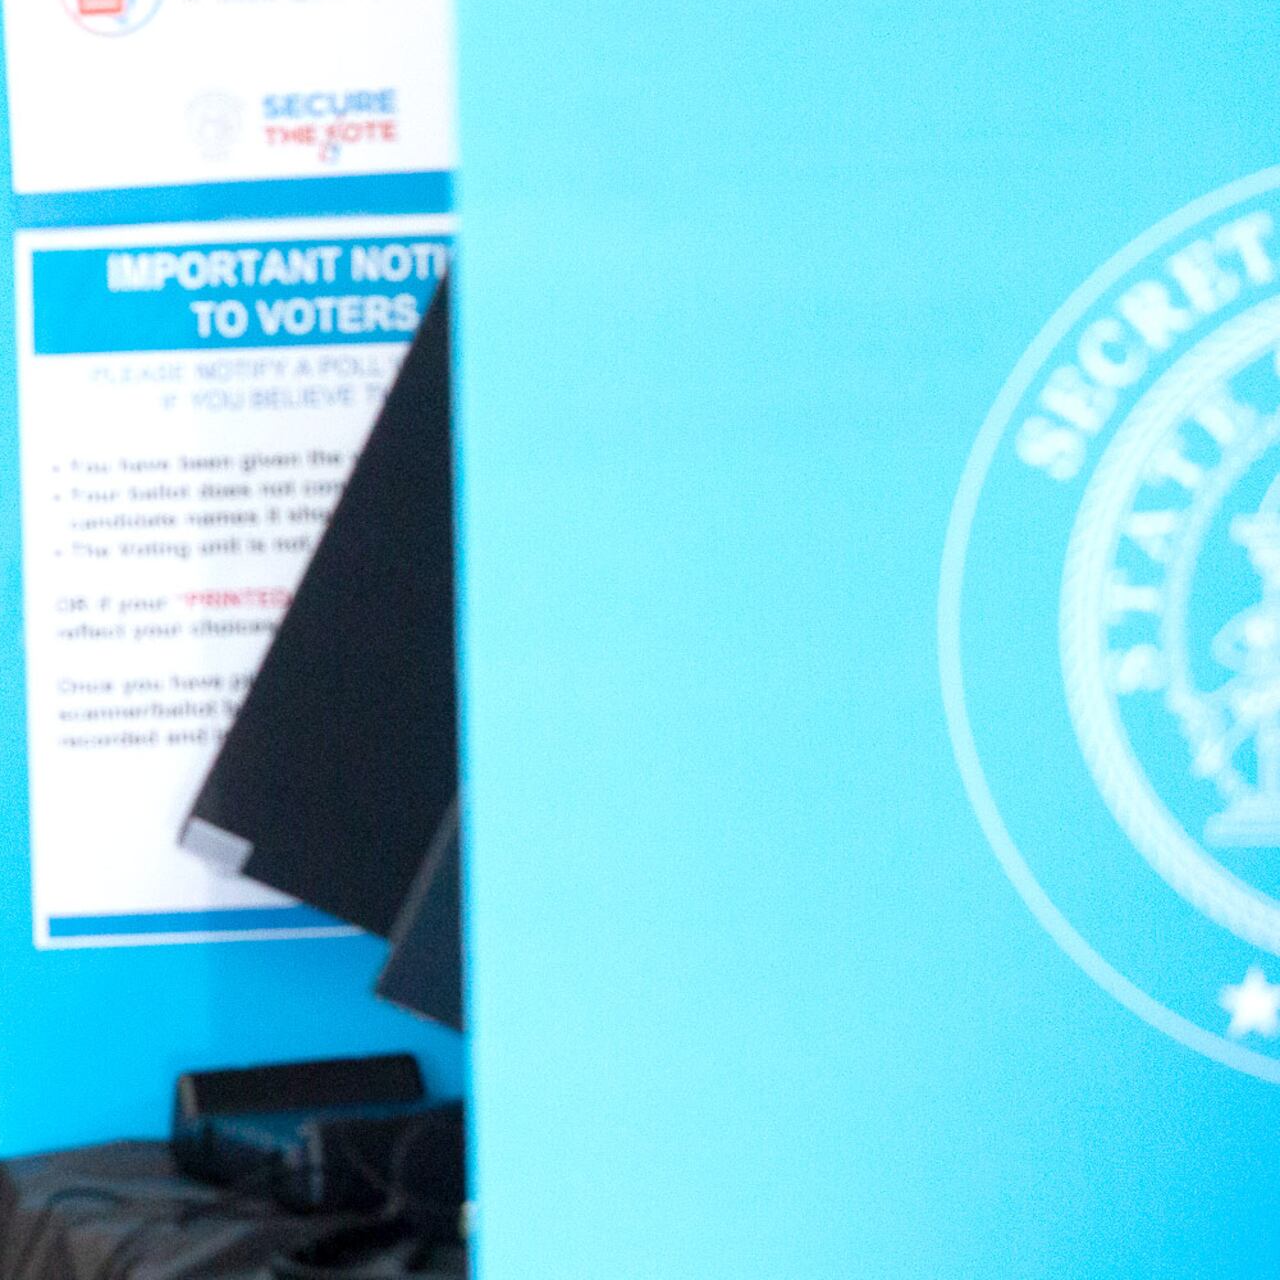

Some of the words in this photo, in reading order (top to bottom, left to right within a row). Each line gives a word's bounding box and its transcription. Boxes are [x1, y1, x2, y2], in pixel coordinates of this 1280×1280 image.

[262, 89, 397, 119] SECURE
[263, 123, 316, 145] THE
[106, 246, 340, 293] IMPORTANT
[349, 242, 448, 283] NOTI
[189, 298, 249, 339] TO
[253, 291, 421, 336] VOTERS
[1014, 210, 1276, 482] SECRET
